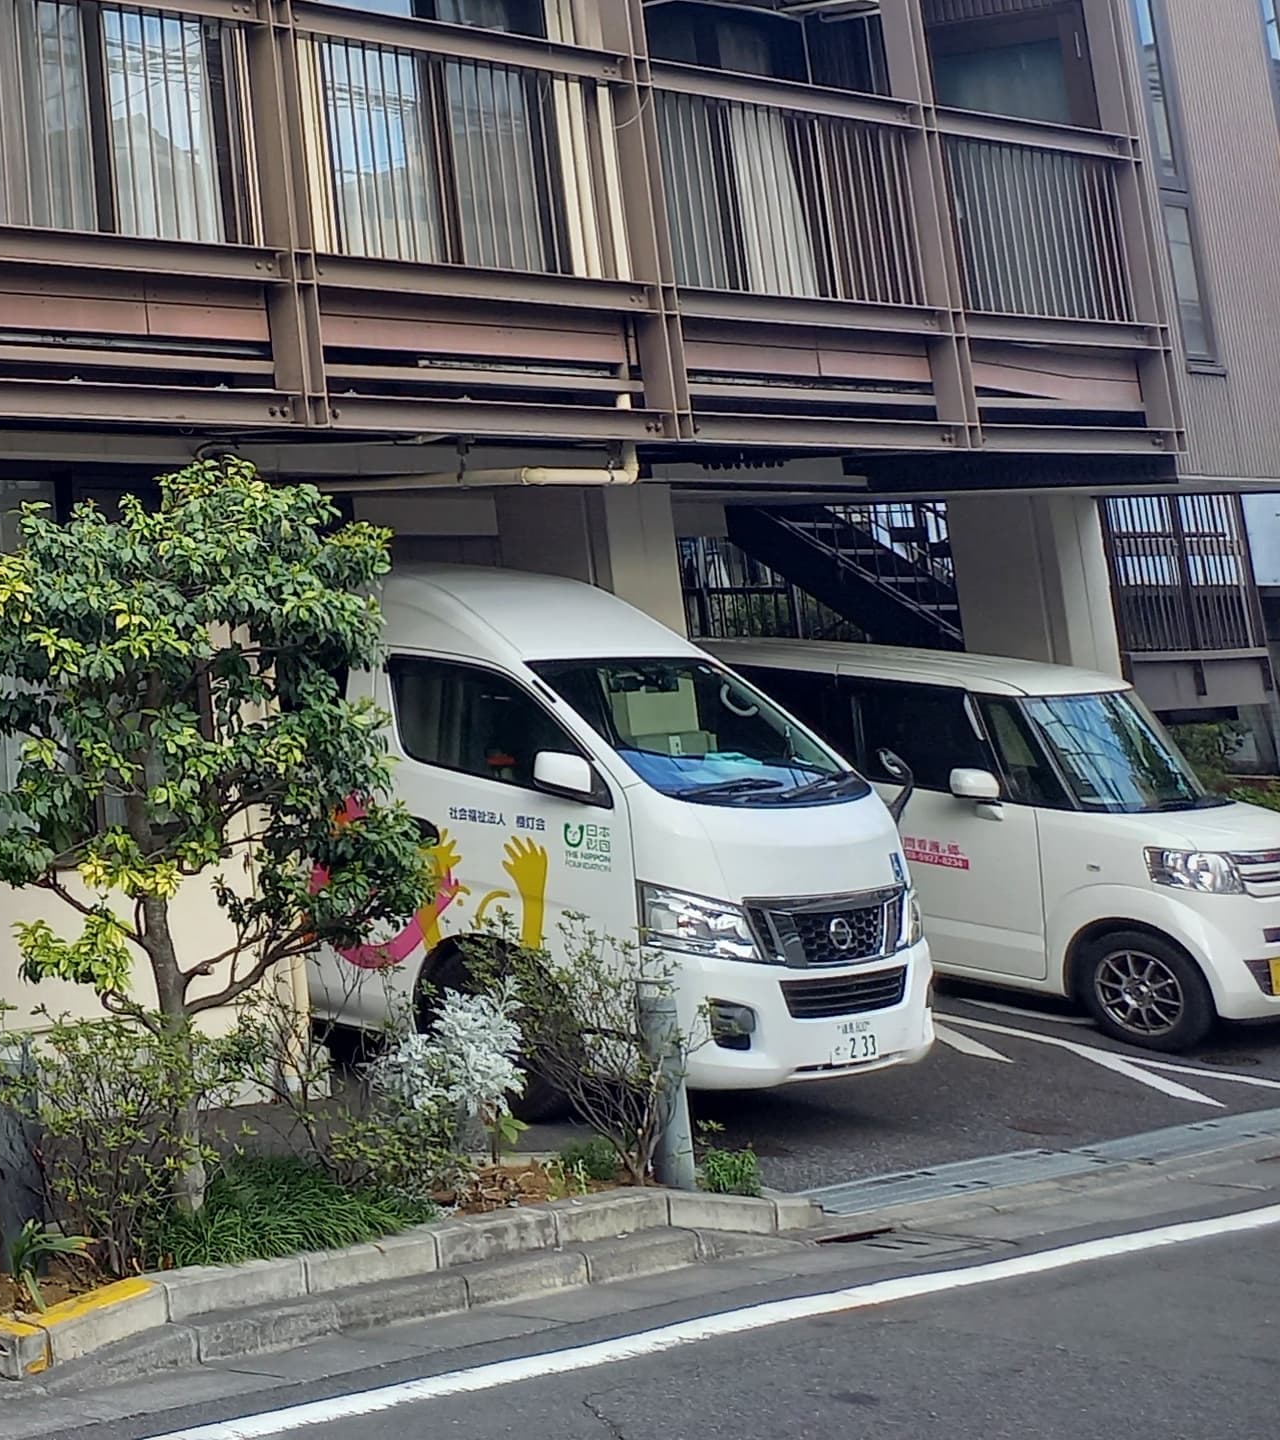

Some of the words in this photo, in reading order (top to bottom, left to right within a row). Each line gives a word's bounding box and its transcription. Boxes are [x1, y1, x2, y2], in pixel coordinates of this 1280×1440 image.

[449, 807, 507, 827] 社会福祉法人
